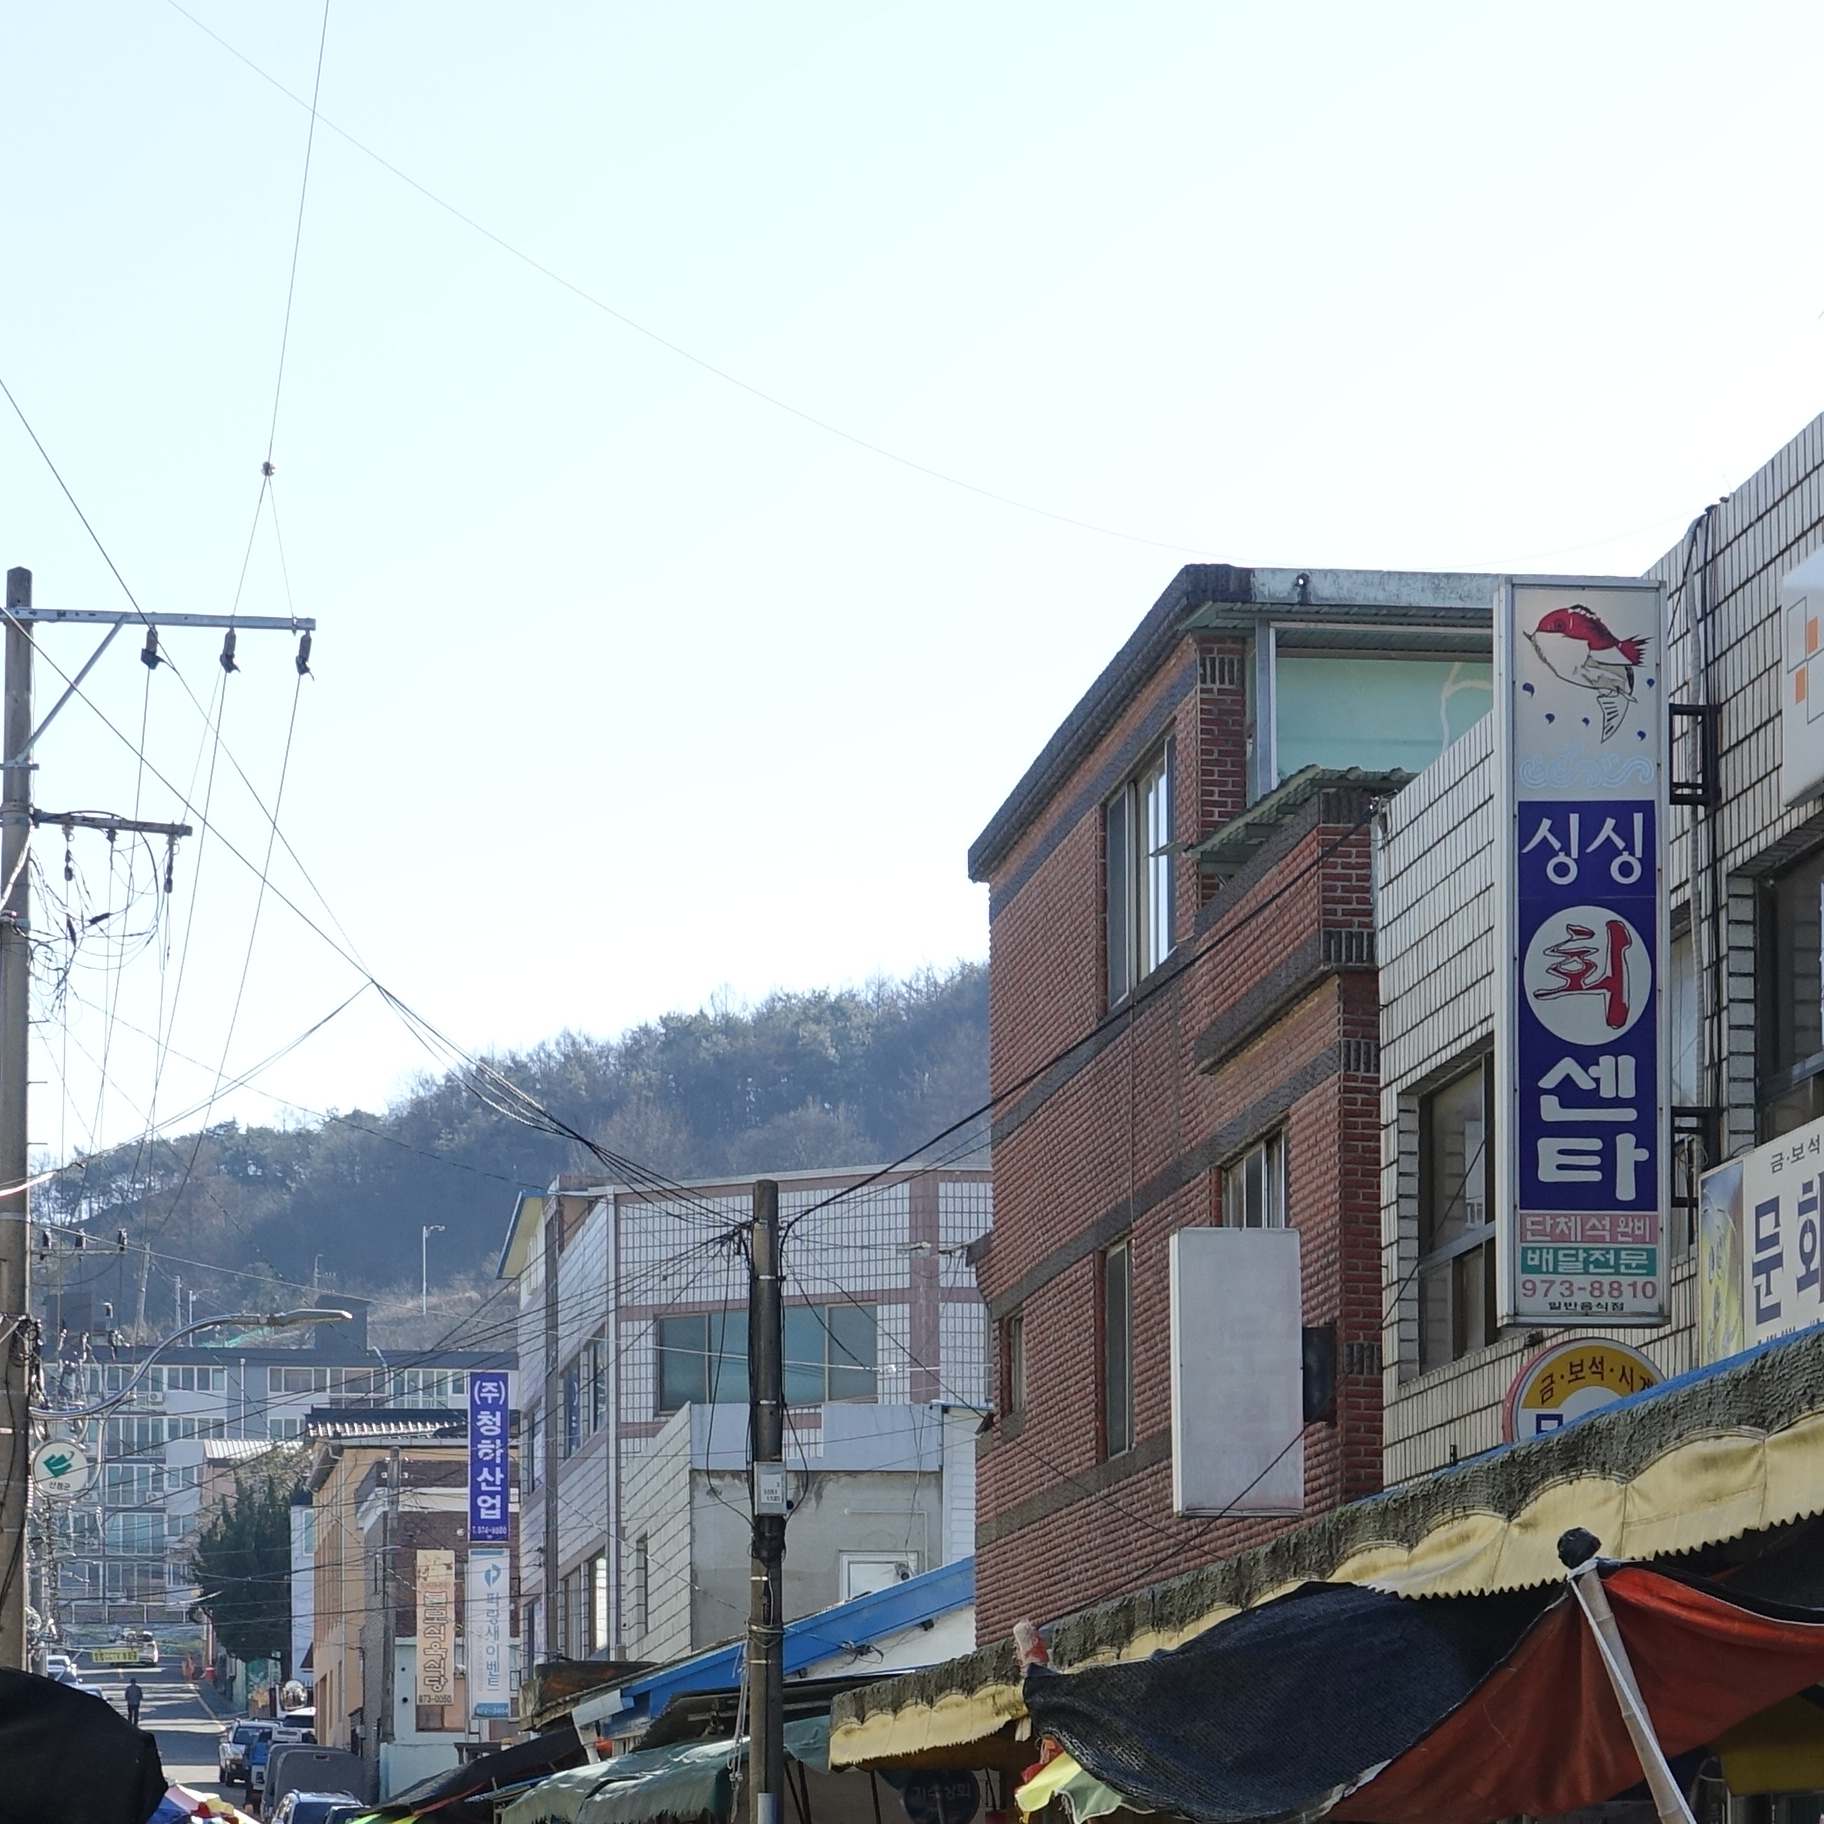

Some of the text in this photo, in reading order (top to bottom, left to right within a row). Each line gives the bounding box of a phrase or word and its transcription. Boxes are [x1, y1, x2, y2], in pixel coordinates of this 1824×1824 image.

[1520, 812, 1646, 886] 싱싱
[1525, 1215, 1651, 1243] 단체석 완비
[1527, 1248, 1649, 1274] 배달전문
[1521, 1278, 1658, 1300] 973-8810
[1547, 1300, 1625, 1313] 일반음식점
[474, 1380, 506, 1406] (주)
